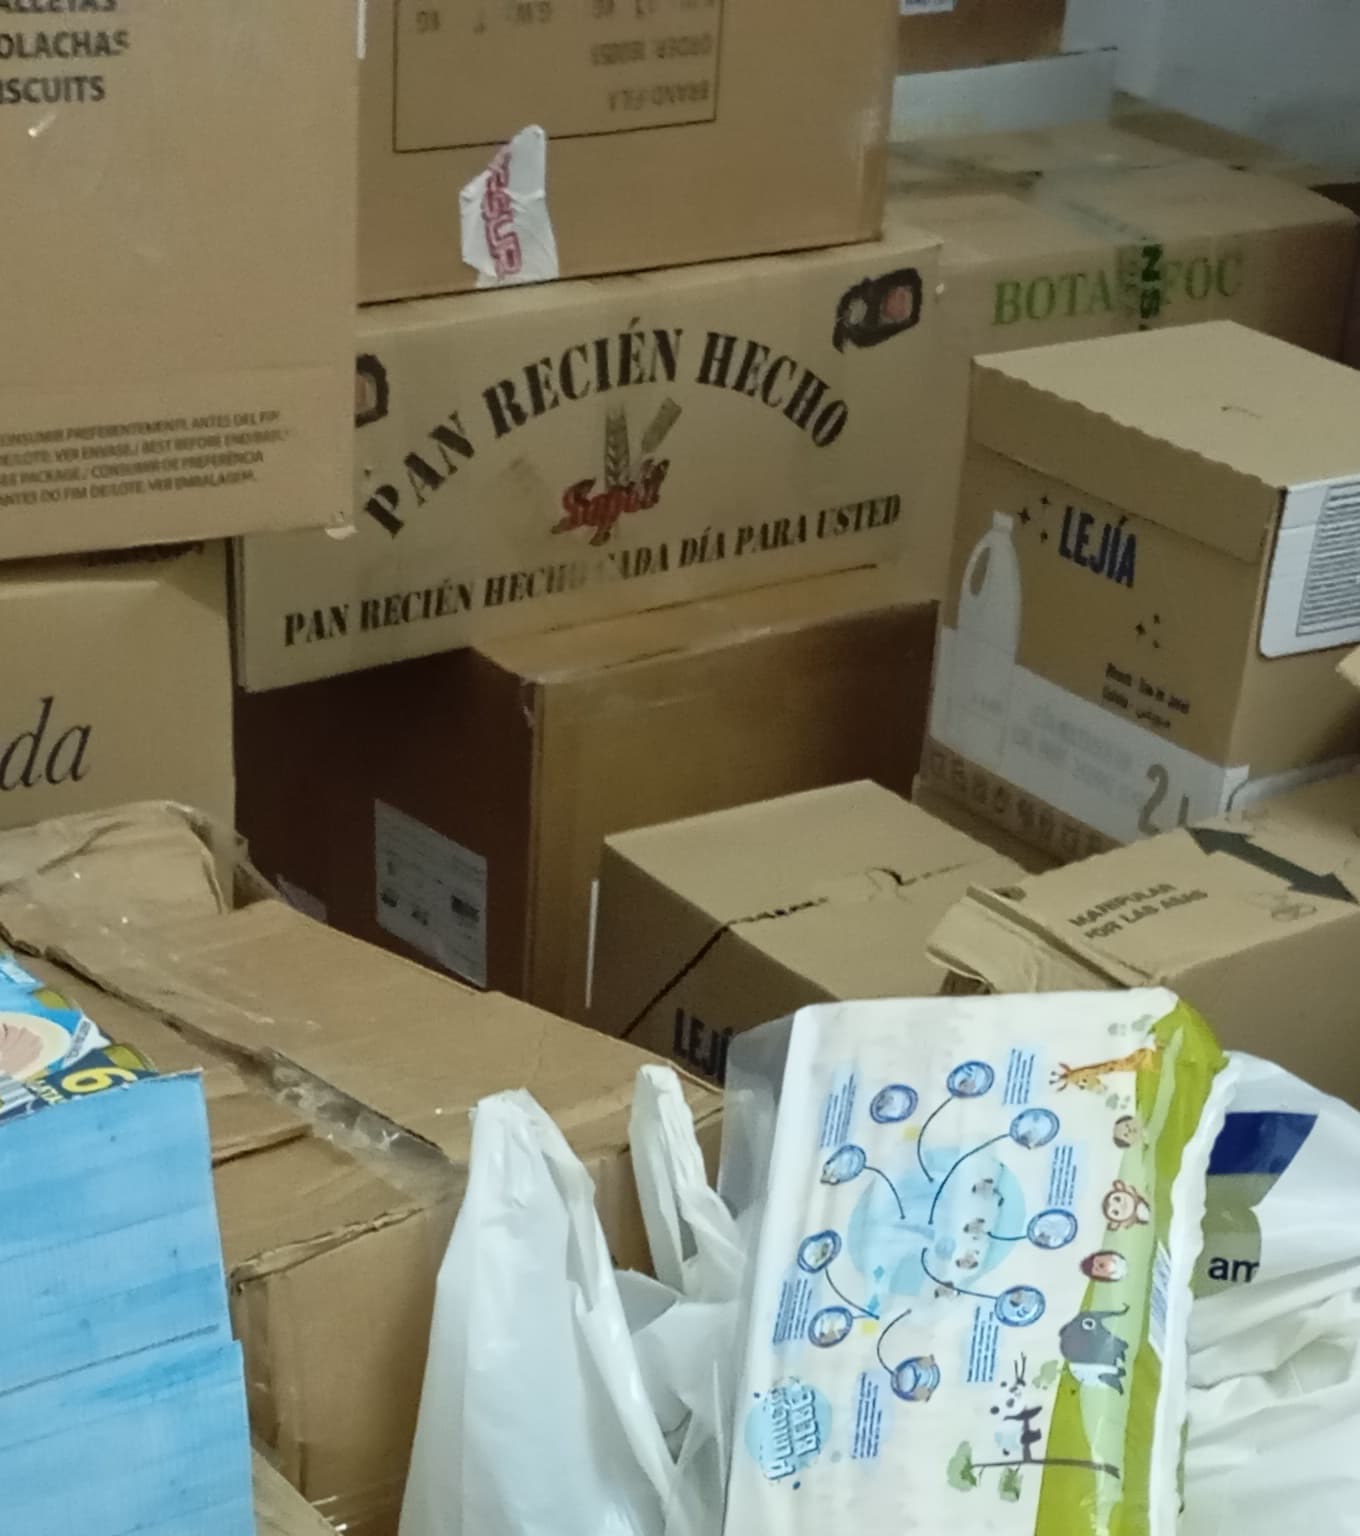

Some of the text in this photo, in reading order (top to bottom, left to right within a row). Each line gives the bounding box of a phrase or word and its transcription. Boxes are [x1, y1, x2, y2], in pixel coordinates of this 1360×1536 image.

[365, 316, 849, 539] PAN RECIÉN HECHO
[283, 602, 352, 647] PAN
[360, 575, 475, 632] RECIÉN
[678, 526, 728, 569] DÍA
[734, 512, 809, 557] PARA
[816, 493, 902, 539] USTED
[1058, 505, 1137, 589] LEJÍA
